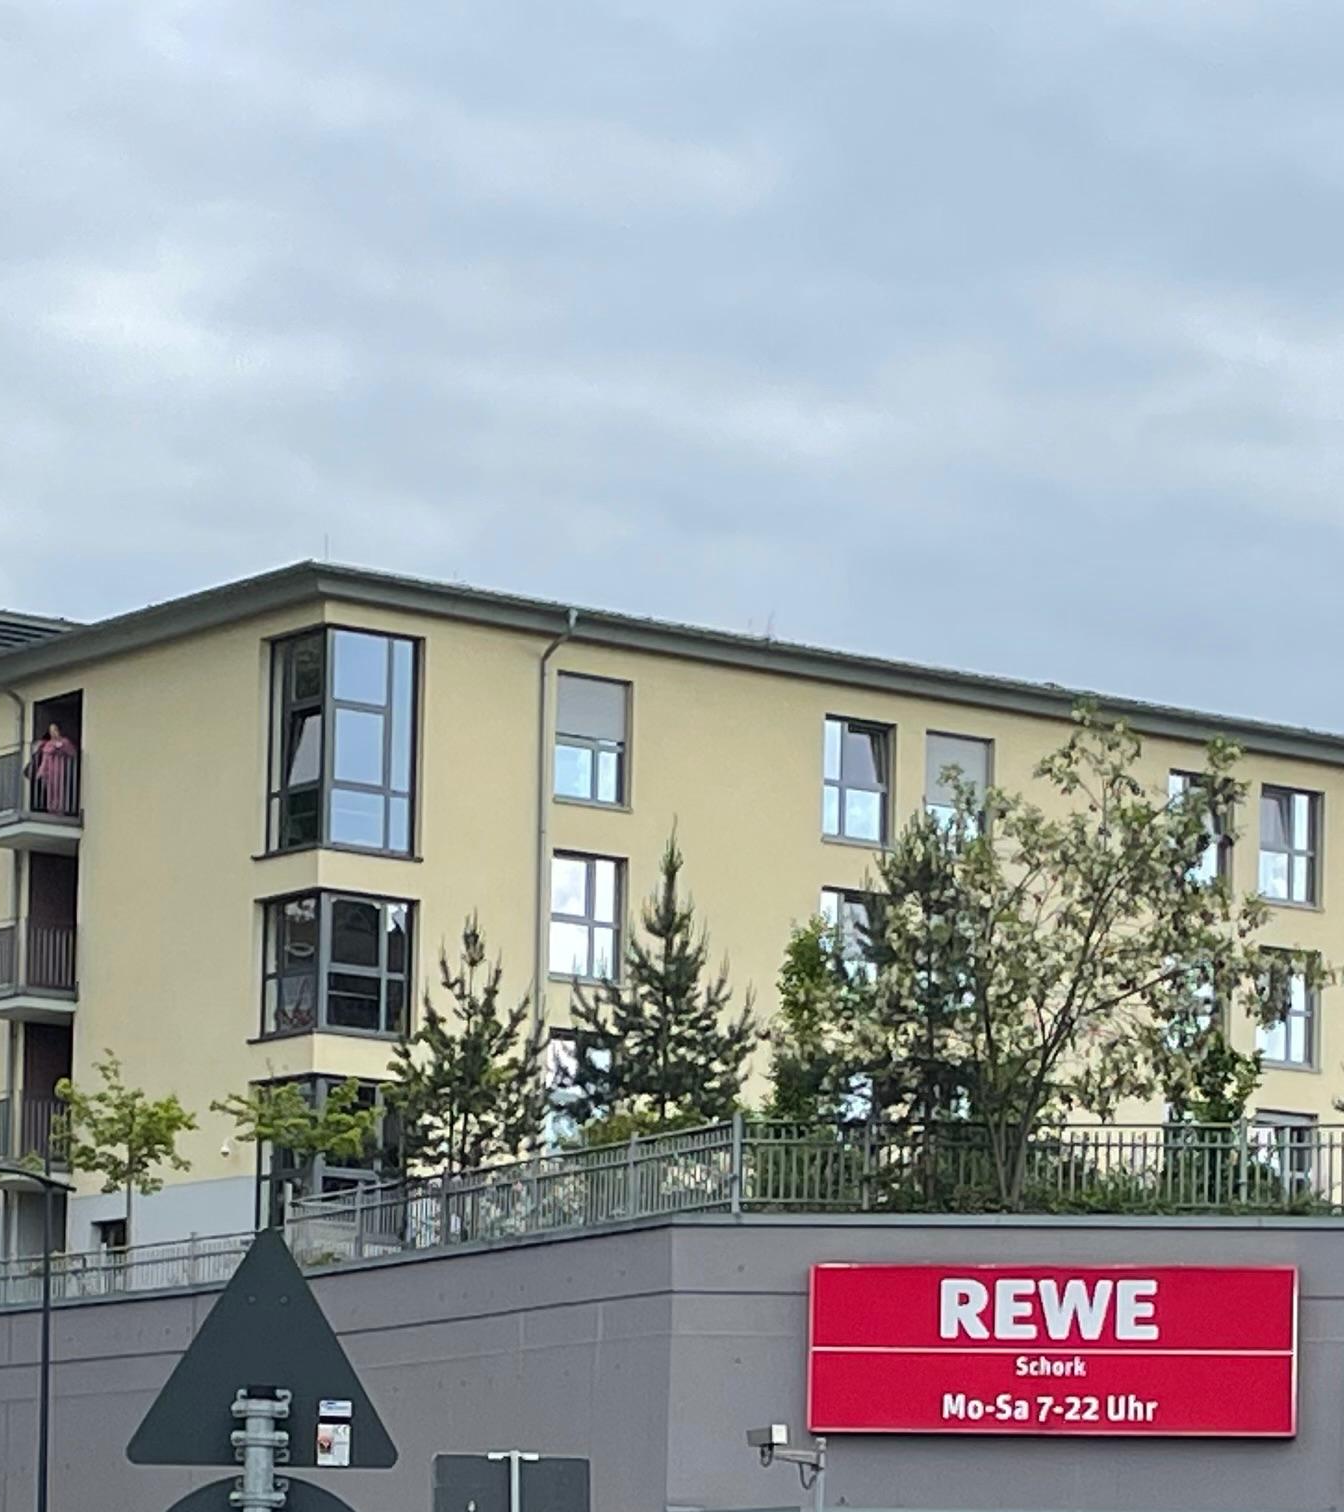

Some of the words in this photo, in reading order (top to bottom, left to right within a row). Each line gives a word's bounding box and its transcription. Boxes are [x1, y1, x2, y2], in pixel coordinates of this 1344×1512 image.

[939, 1278, 1159, 1341] REWE
[1015, 1356, 1086, 1377] Schork
[942, 1394, 1030, 1421] Mo-Sa
[1036, 1396, 1100, 1423] 7-22
[1106, 1394, 1158, 1423] Uhr
